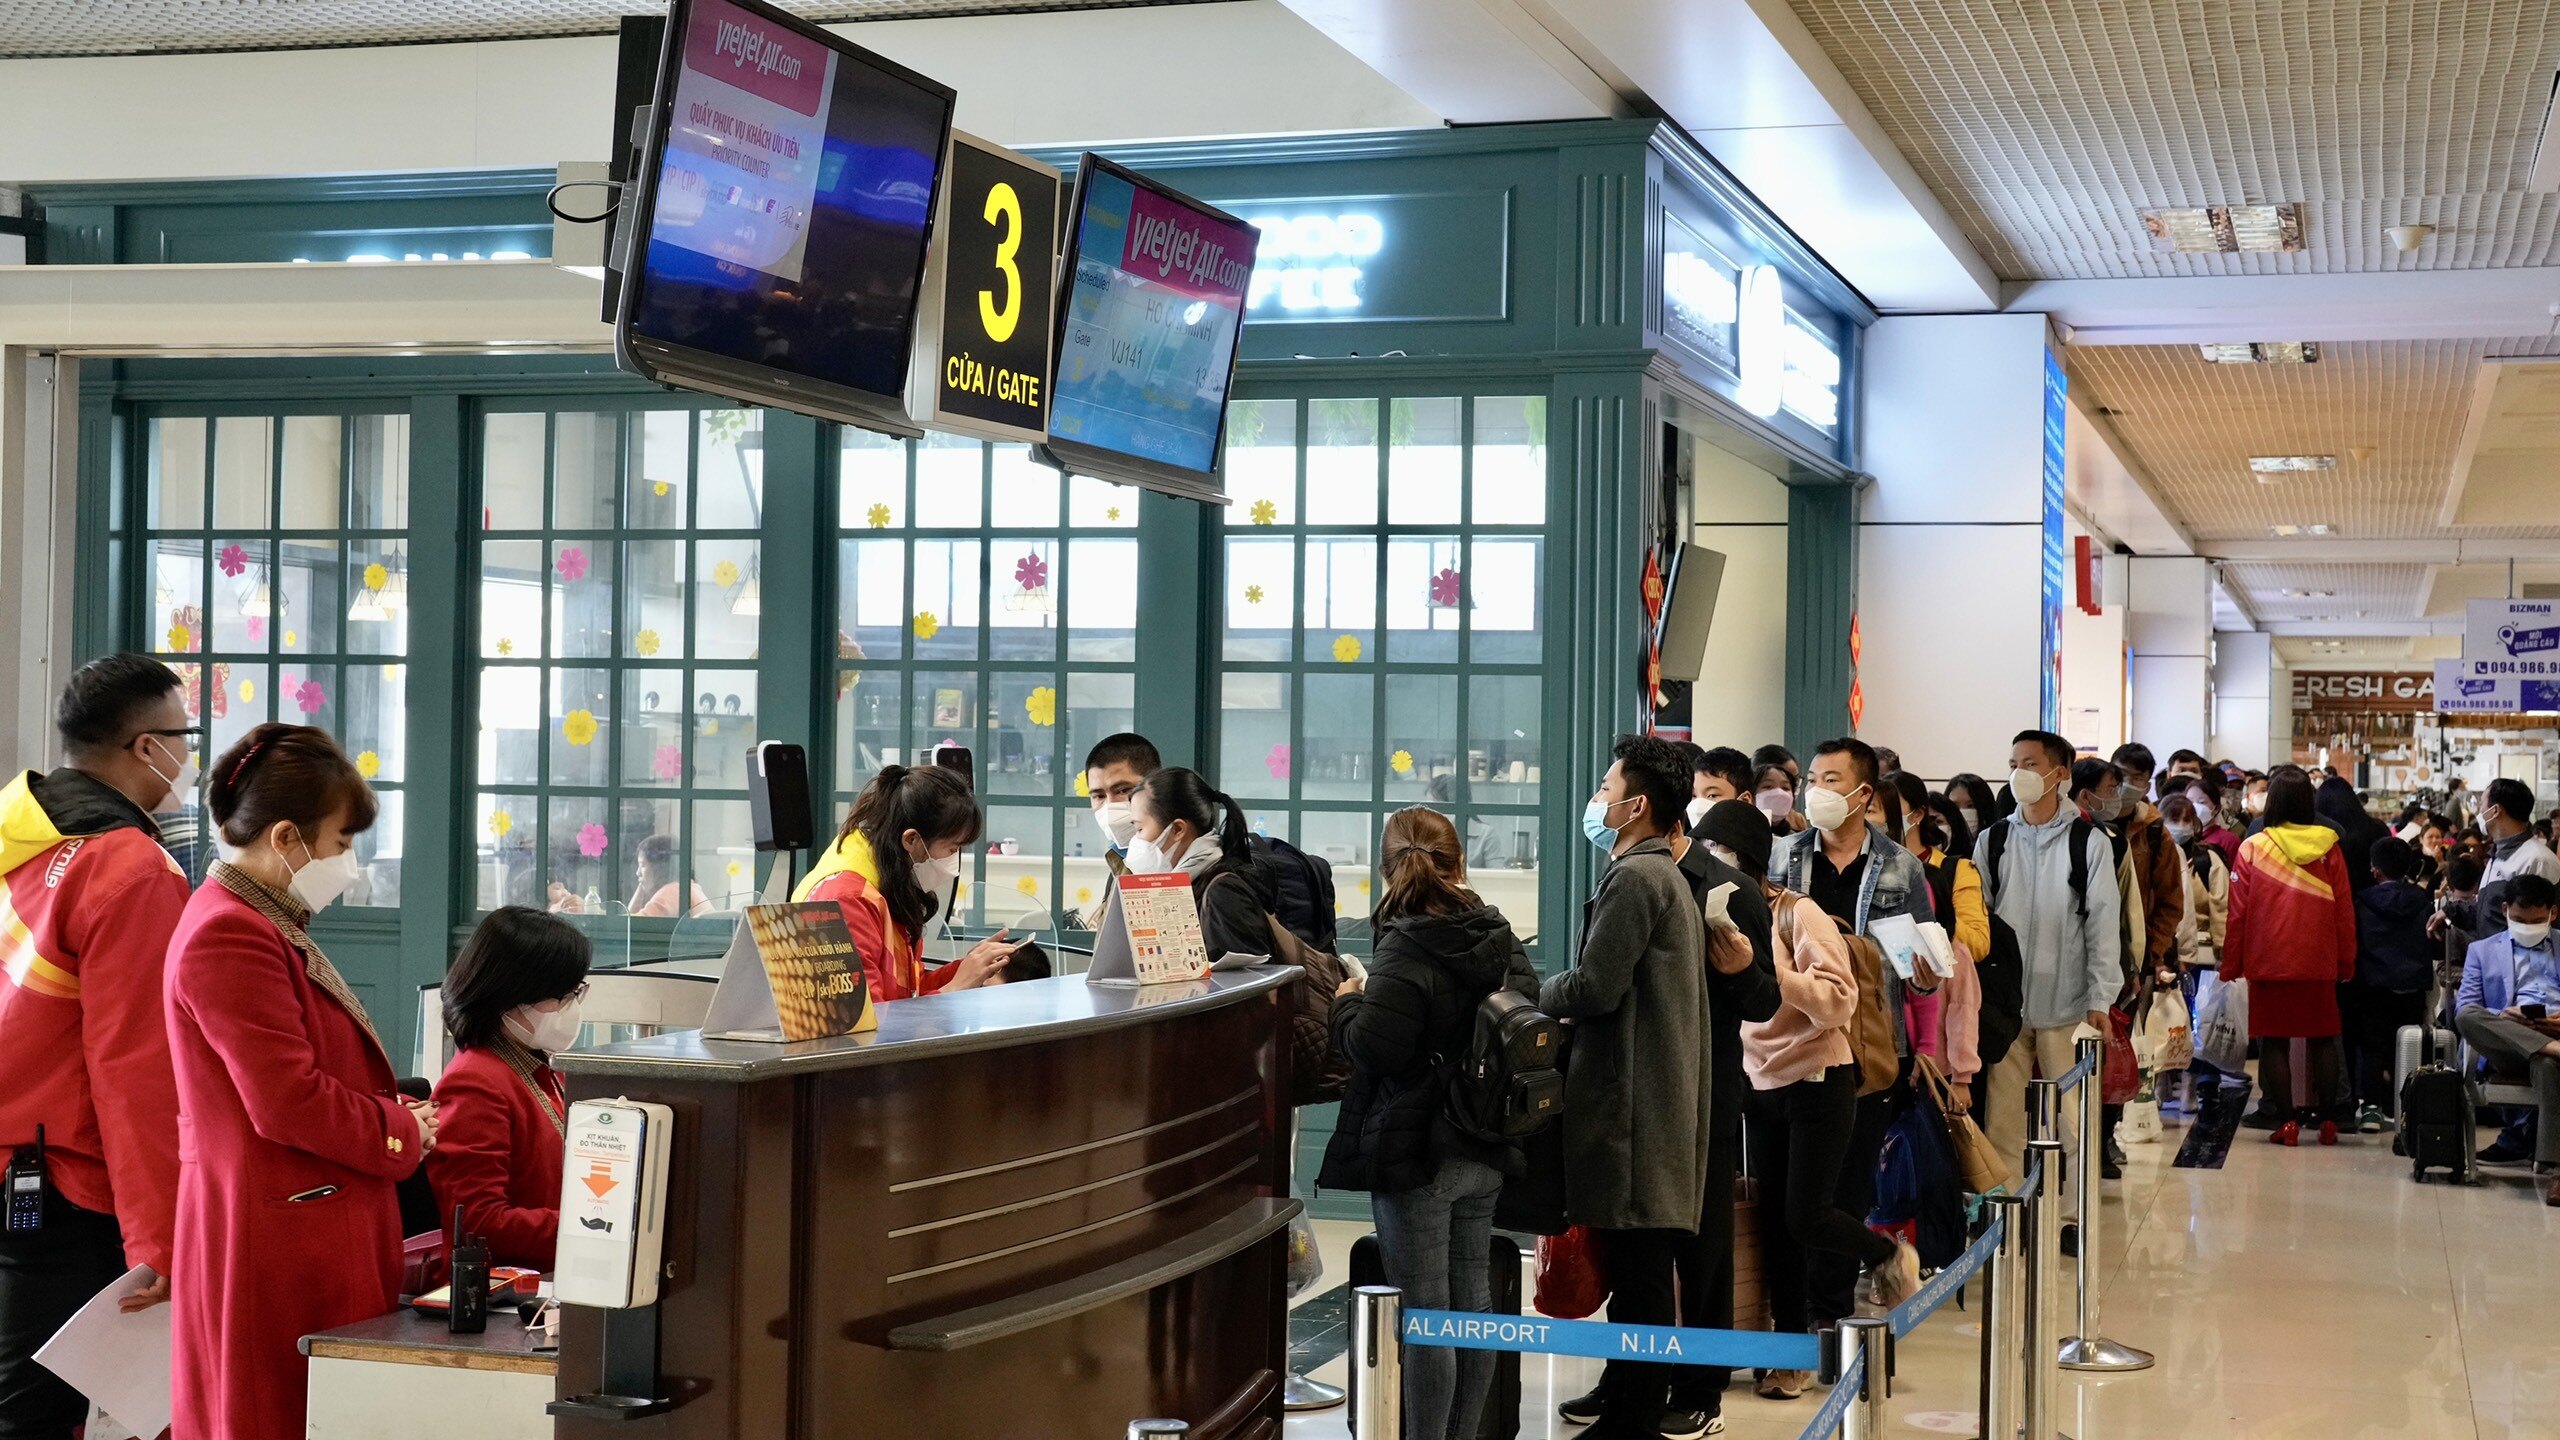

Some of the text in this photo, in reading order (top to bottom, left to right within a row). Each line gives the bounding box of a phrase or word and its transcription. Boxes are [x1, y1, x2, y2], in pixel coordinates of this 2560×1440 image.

[741, 154, 770, 180] COUNTER
[979, 182, 1022, 342] 3
[1077, 267, 1110, 292] Scheduled
[1074, 329, 1091, 348] Gate
[1110, 338, 1144, 370] VJ141
[947, 352, 984, 395] CỬA
[997, 368, 1039, 407] GATE
[2509, 604, 2551, 613] BIZMAN
[814, 960, 847, 976] BOARDING
[1440, 1318, 1550, 1344] AIRPORT
[1621, 1332, 1683, 1356] N.I.A
